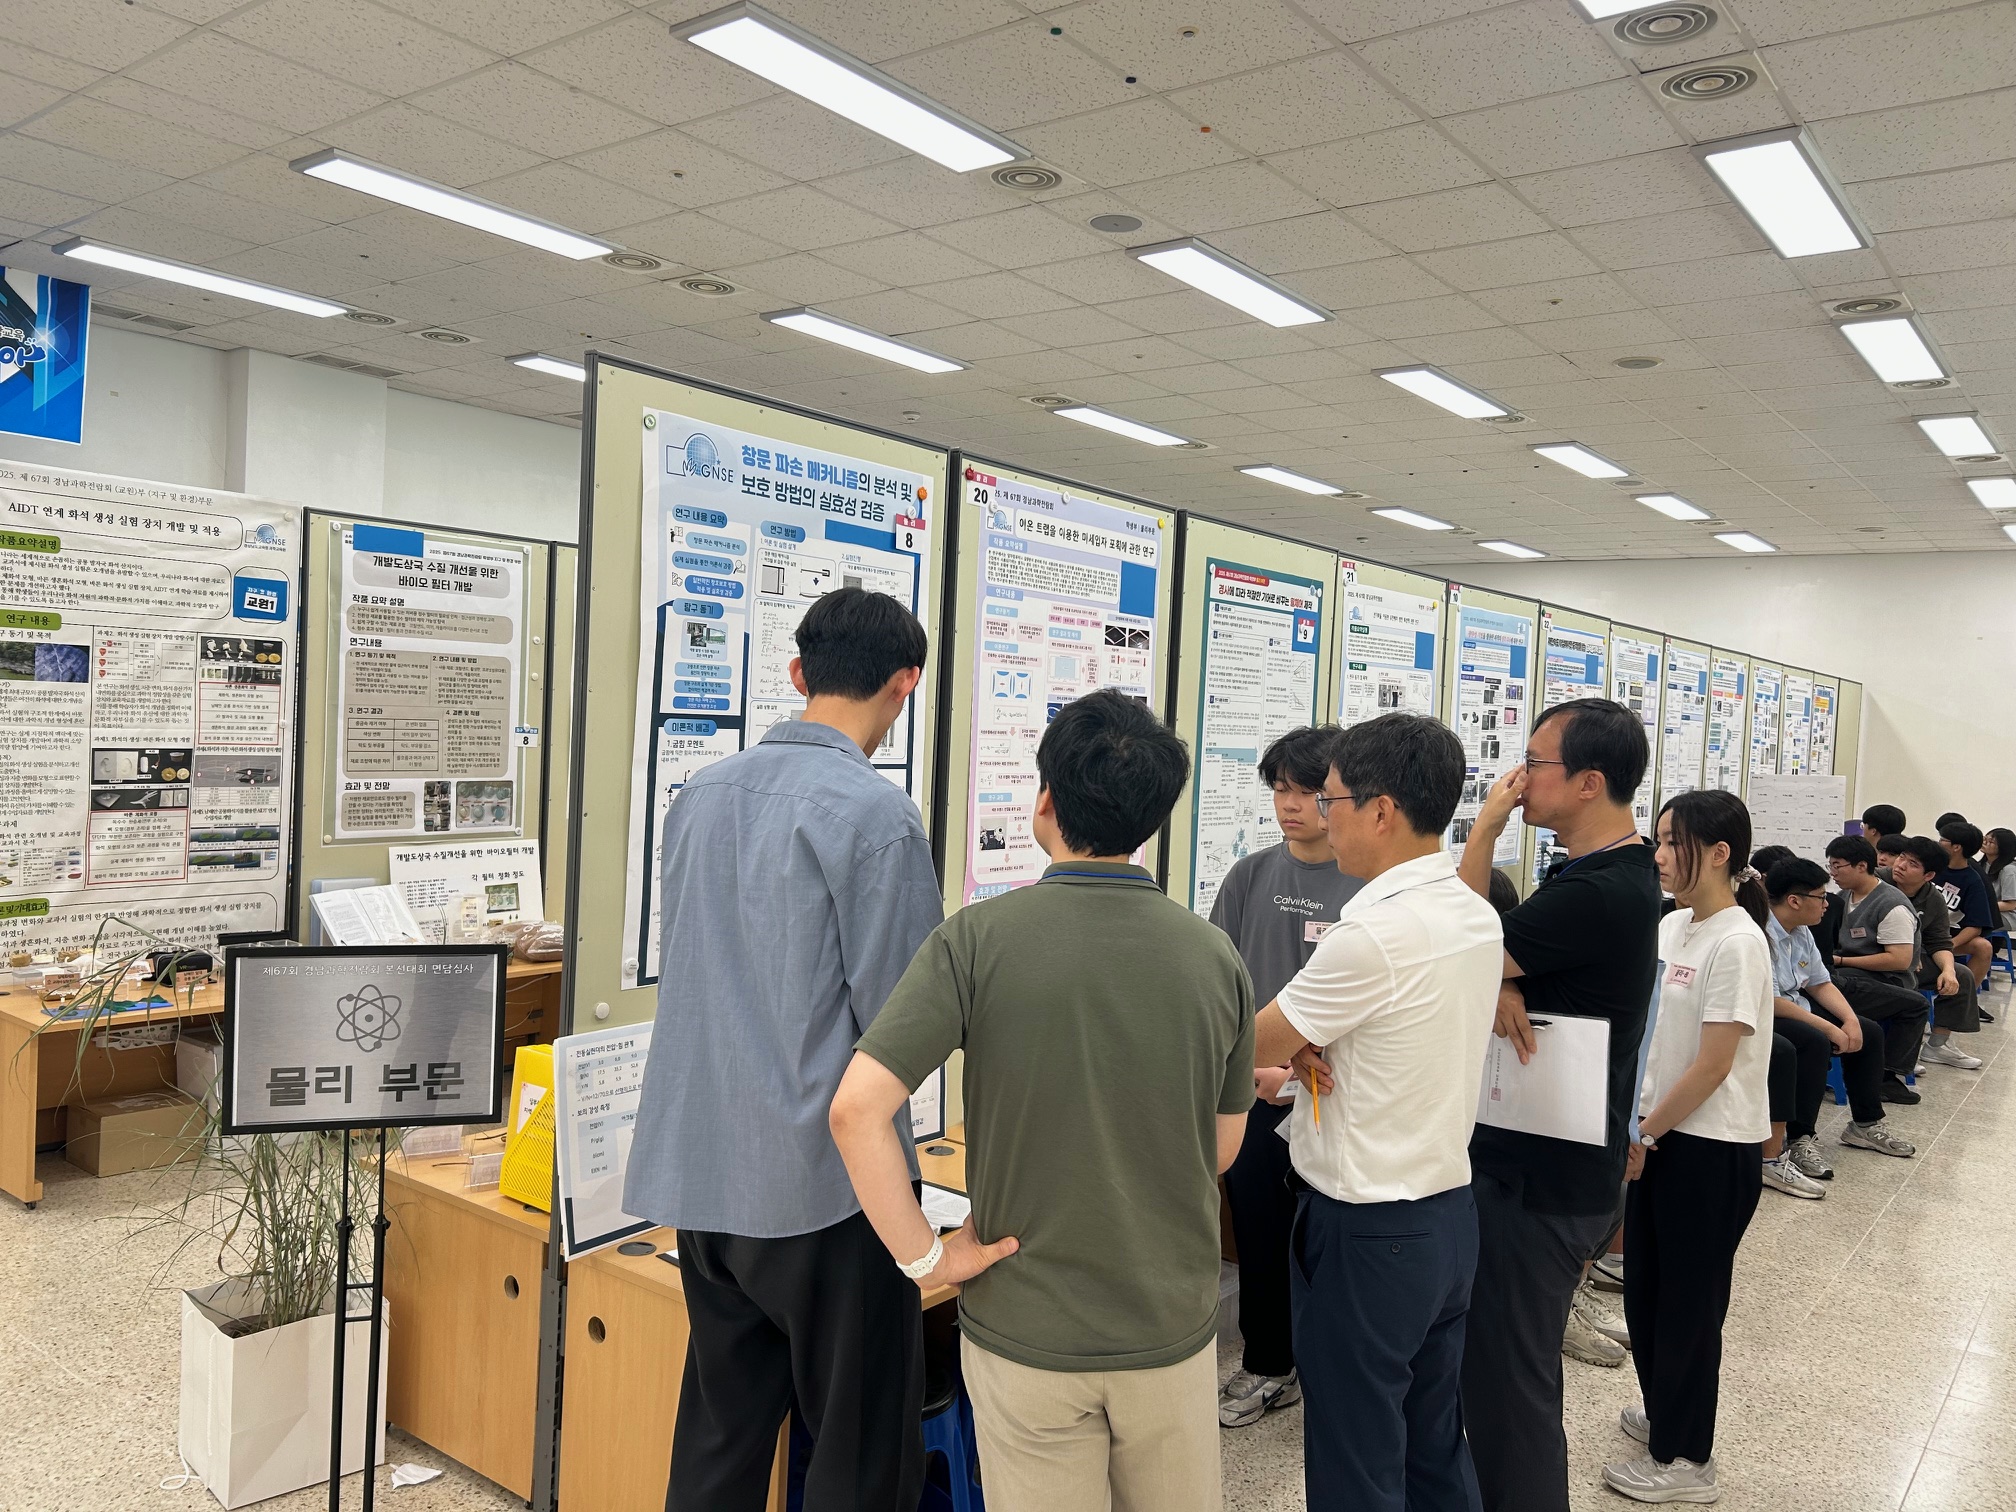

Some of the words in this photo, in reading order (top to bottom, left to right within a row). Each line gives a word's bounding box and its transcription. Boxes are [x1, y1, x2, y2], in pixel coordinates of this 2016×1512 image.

[742, 444, 771, 471] 창문
[775, 453, 803, 478] 파손
[807, 460, 871, 493] 메커니즘의
[874, 476, 898, 499] 분석
[900, 482, 912, 503] 및
[20, 473, 28, 482] 제
[31, 474, 50, 484] 67회
[53, 477, 112, 493] 경남과학전람회
[170, 493, 177, 502] 및
[742, 474, 771, 499] 보호
[775, 481, 816, 509] 방법의
[820, 492, 857, 517] 실효성
[860, 500, 885, 523] 검증
[974, 488, 988, 505] 20
[8, 502, 38, 514] AIDT
[43, 506, 64, 519] 연계
[68, 509, 89, 522] 화석
[93, 512, 114, 525] 생성
[119, 516, 138, 527] 실험
[142, 518, 162, 530] 장치
[166, 522, 185, 533] 개발
[190, 524, 199, 534] 및
[202, 526, 222, 537] 적용
[676, 508, 690, 518] 연구
[692, 511, 708, 521] 내용
[710, 514, 725, 525] 요약
[770, 526, 782, 536] 연구
[784, 528, 797, 539] 방법
[1020, 518, 1034, 532] 이온
[1036, 522, 1056, 538] 트랩을
[1059, 527, 1080, 543] 이용한
[1082, 532, 1108, 549] 미세입자
[1110, 538, 1127, 553] 포획에
[1129, 543, 1141, 556] 관한
[1142, 546, 1155, 559] 연구
[906, 533, 913, 548] 8
[373, 555, 423, 571] 개발도상국
[427, 562, 446, 574] 수질
[450, 564, 477, 578] 개선을
[480, 568, 498, 580] 위한
[399, 576, 428, 588] 바이오
[432, 578, 450, 591] 필터
[454, 581, 473, 593] 개발
[246, 596, 275, 611] 교원1
[352, 594, 369, 604] 작품
[371, 596, 387, 605] 요약
[390, 598, 405, 607] 설명
[684, 602, 698, 613] 탐구
[700, 604, 714, 615] 동기
[6, 614, 27, 625] 연구
[31, 616, 50, 626] 내용
[9, 630, 24, 638] 동기
[27, 631, 34, 639] 및
[1303, 629, 1308, 640] 9
[350, 638, 382, 648] 연구내용
[672, 722, 694, 733] 이론적
[696, 723, 710, 733] 배경
[522, 736, 529, 746] 8
[344, 782, 361, 791] 효과
[364, 782, 372, 791] 및
[374, 782, 390, 791] 전망
[396, 852, 431, 862] 개발도상국
[434, 850, 467, 860] 수질개선을
[470, 850, 483, 858] 위한
[486, 847, 519, 856] 바이오필터
[522, 846, 534, 855] 개발
[482, 872, 494, 880] 필터
[512, 870, 525, 878] 정도
[1300, 898, 1324, 910] Klein
[20, 916, 44, 927] 변화와
[46, 915, 68, 924] 교과서
[70, 913, 92, 923] 실험의
[118, 909, 140, 920] 반영해
[141, 907, 175, 918] 과학적으로
[178, 906, 197, 915] 정합한
[200, 904, 212, 913] 화석
[214, 904, 227, 912] 생성
[229, 902, 242, 911] 실험
[244, 901, 262, 910] 장치를
[0, 929, 26, 938] 하였다.
[20, 938, 52, 948] 생흔화석,
[54, 936, 69, 945] 지층
[72, 934, 86, 943] 변화
[172, 926, 185, 934] 개념
[187, 924, 207, 933] 이해를
[208, 924, 230, 932] 높였다.
[184, 934, 197, 943] 유산
[263, 966, 298, 976] 제67회
[304, 964, 380, 976] 경남과학전람회
[385, 964, 428, 975] 본선대회
[432, 964, 474, 975] 면담심사
[266, 1065, 353, 1107] 물리
[378, 1062, 465, 1102] 부문
